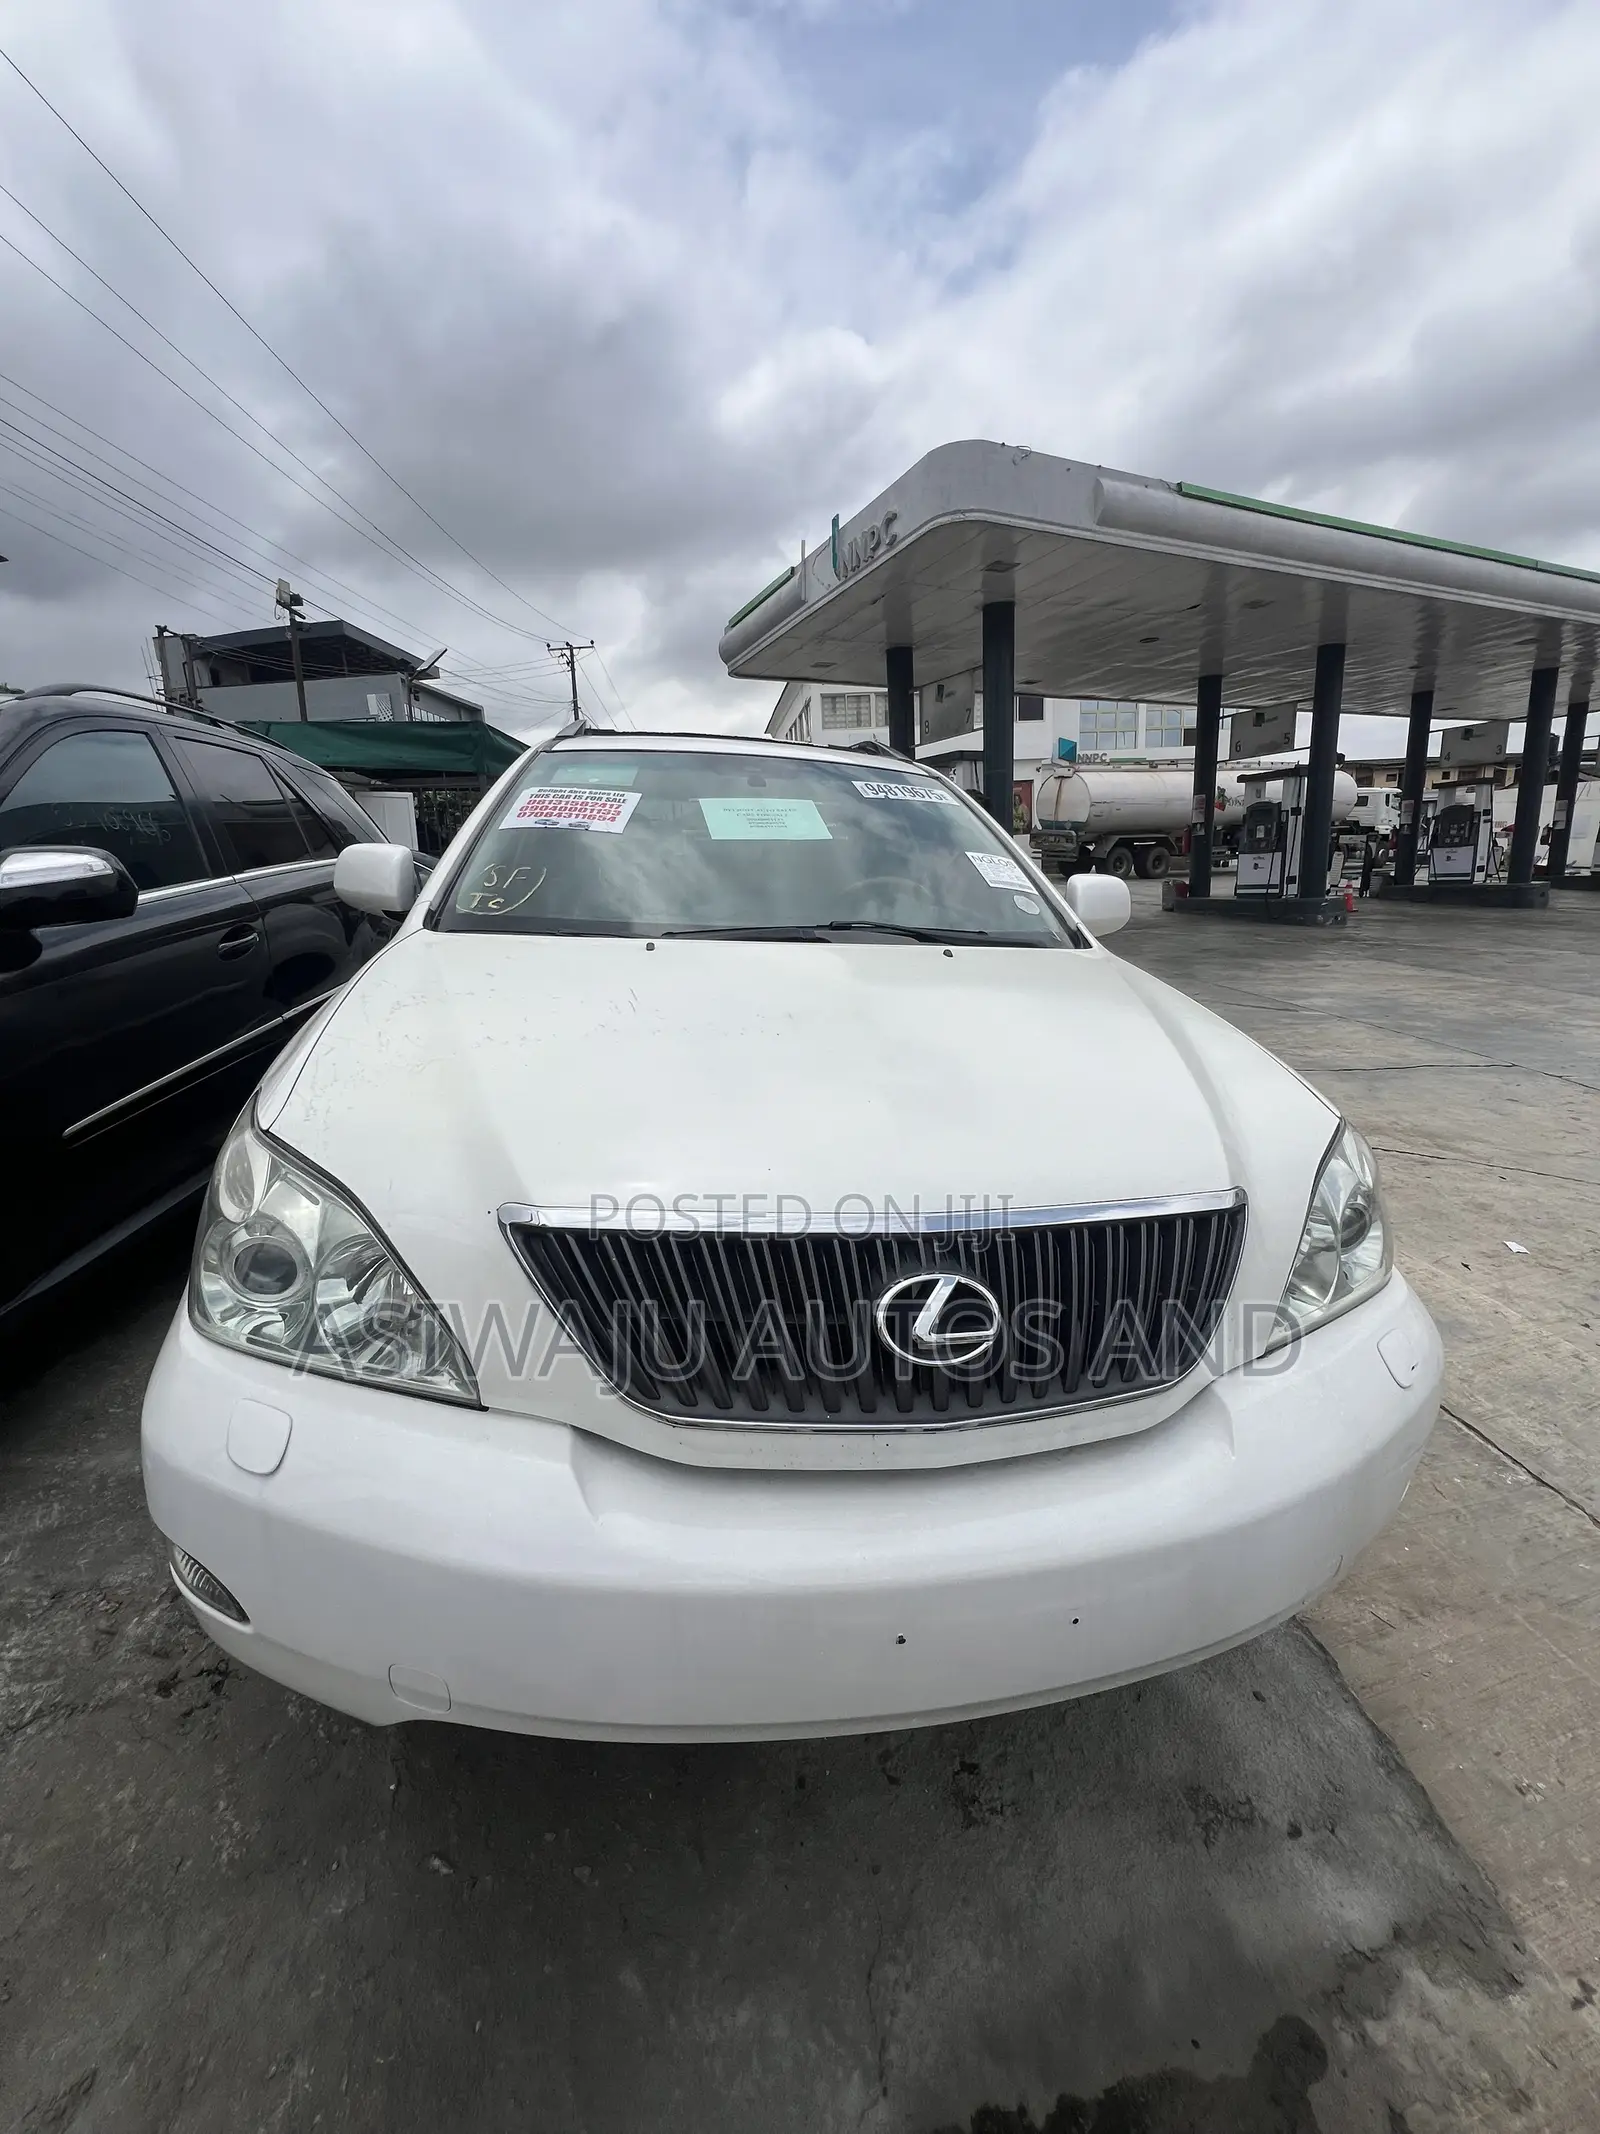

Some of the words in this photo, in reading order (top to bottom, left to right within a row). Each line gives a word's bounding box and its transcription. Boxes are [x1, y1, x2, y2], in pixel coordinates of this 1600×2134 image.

[925, 720, 930, 735] 8
[965, 708, 972, 724] 7
[1235, 741, 1242, 752] 6
[1284, 732, 1291, 744] 5
[1078, 753, 1108, 764] NNPC
[1444, 752, 1451, 761] 4
[1495, 745, 1502, 755] 3
